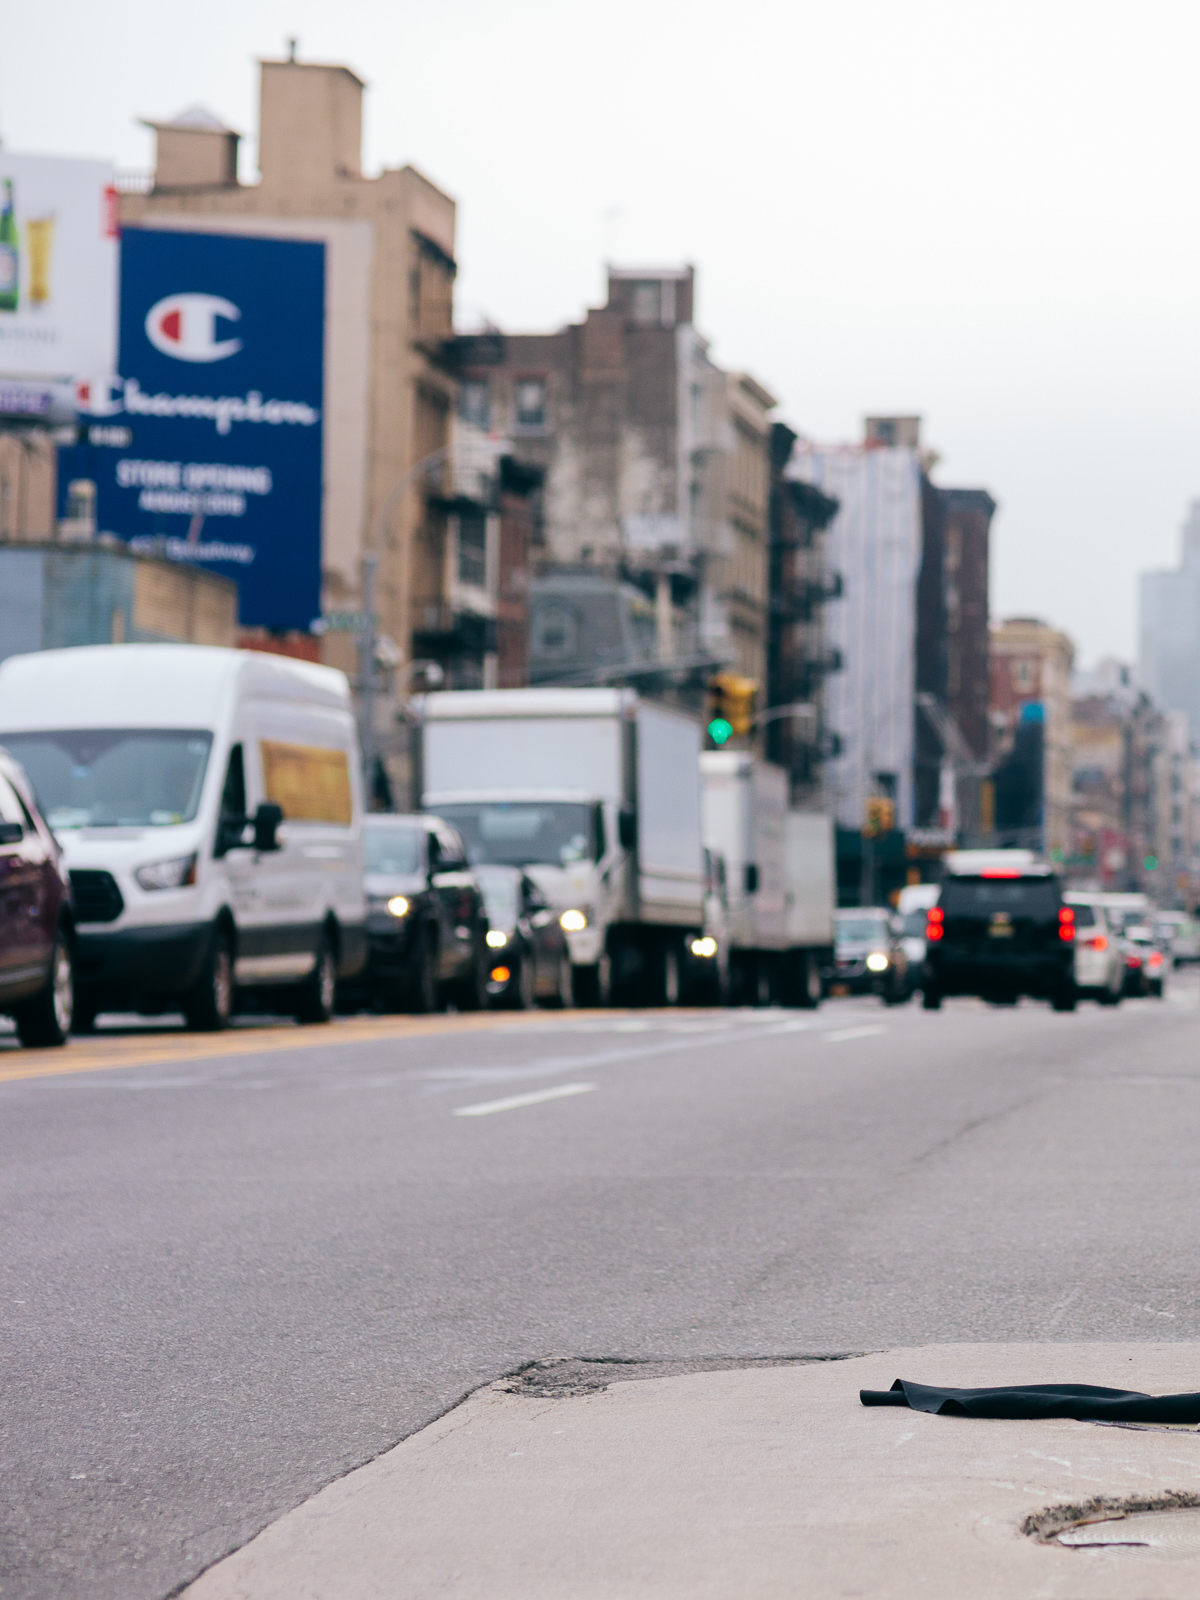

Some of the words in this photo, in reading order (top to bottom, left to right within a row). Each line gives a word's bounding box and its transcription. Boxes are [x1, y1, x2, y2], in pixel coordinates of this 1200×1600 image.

[74, 374, 320, 436] Champion
[116, 459, 181, 490] STORE
[183, 463, 272, 496] OPENING
